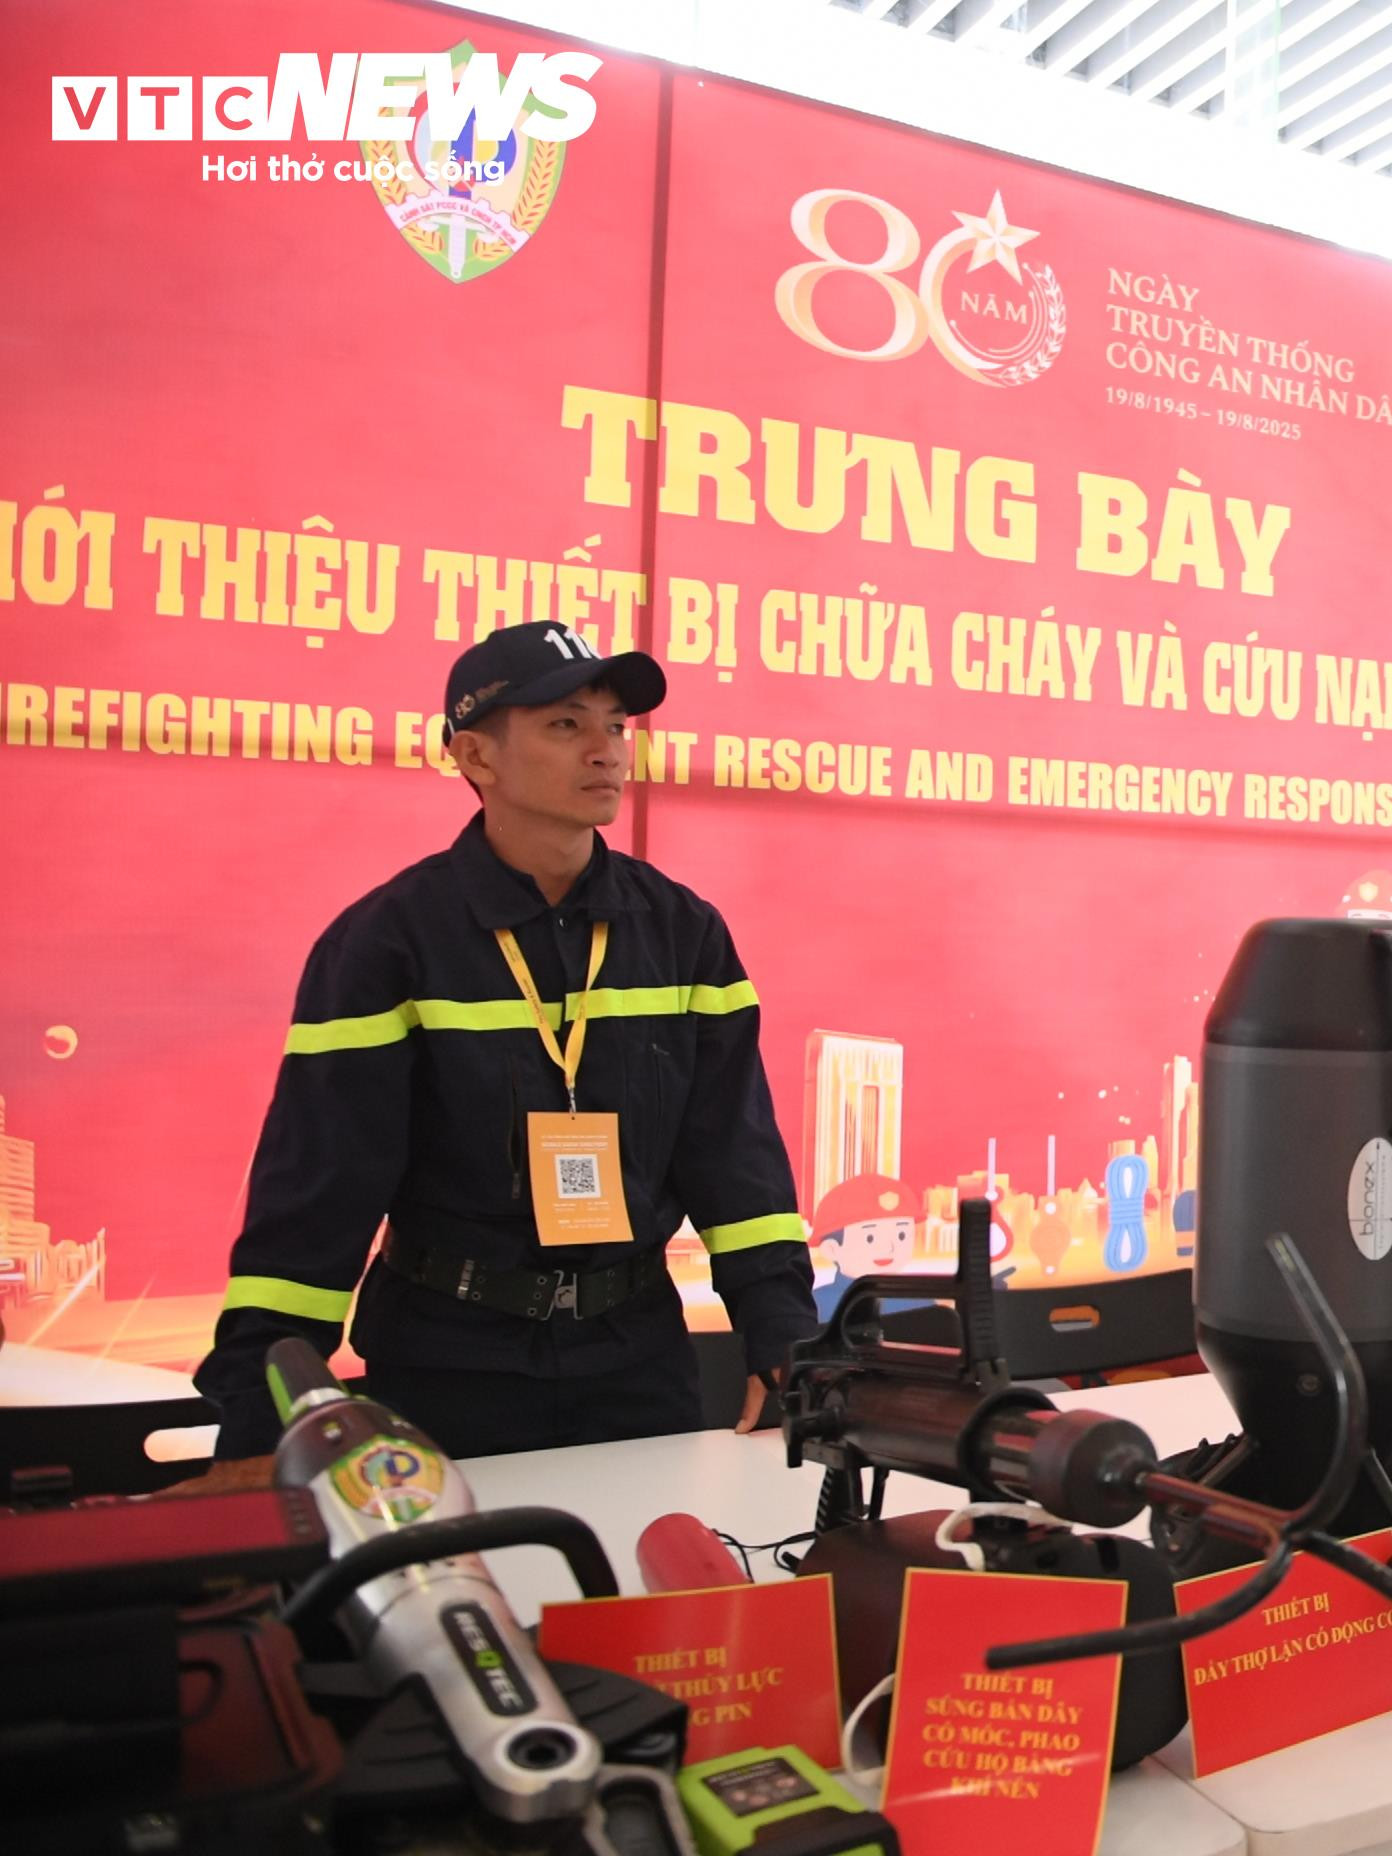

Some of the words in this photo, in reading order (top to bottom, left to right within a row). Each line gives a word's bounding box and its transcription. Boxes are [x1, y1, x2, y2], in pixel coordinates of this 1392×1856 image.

[775, 188, 1067, 387] 80
[961, 290, 1030, 325] NĂM
[1106, 267, 1200, 314] NGÀY
[1106, 303, 1241, 357] TRUYỀN
[1246, 339, 1355, 383] THỐNG
[1106, 341, 1202, 384] CÔNG
[1207, 364, 1252, 395] AN
[1261, 381, 1350, 416] NHÂN
[1106, 386, 1198, 420] 19/8/1945
[1216, 408, 1302, 441] 19/8/2025
[557, 384, 1038, 564] TRƯNG
[1076, 467, 1291, 597] BÀY
[0, 484, 115, 610] IỚI
[143, 514, 400, 649] THIỆU
[422, 533, 647, 658] THIẾT
[667, 577, 738, 683] BỊ
[760, 582, 933, 687] CHỮA
[951, 606, 1102, 702] CHÁY
[1116, 621, 1188, 711] VÀ
[1203, 630, 1302, 721] CỨU
[544, 627, 602, 660] 11
[0, 683, 374, 766] REFIGHTING
[714, 734, 893, 797] RESCUE
[905, 749, 994, 803] AND
[1008, 756, 1233, 817] EMERGENCY
[1359, 1160, 1376, 1236] bonex
[1261, 1596, 1311, 1626] THIẾT
[1313, 1592, 1329, 1613] BỊ
[634, 1647, 698, 1674] THIẾT
[704, 1646, 727, 1669] BỊ
[1232, 1646, 1270, 1671] THỢ
[1305, 1627, 1329, 1651] CÓ
[1331, 1618, 1375, 1644] ĐỘNG
[736, 1667, 784, 1693] LỰC
[962, 1671, 1027, 1694] THIẾT
[1031, 1677, 1054, 1700] BỊ
[715, 1701, 753, 1724] PIN
[924, 1696, 983, 1719] SÚNG
[1036, 1702, 1083, 1725] DÂY
[922, 1720, 954, 1742] CÓ
[1019, 1730, 1081, 1751] PHAO
[923, 1745, 972, 1769] CỨU
[975, 1753, 1009, 1776] HỘ
